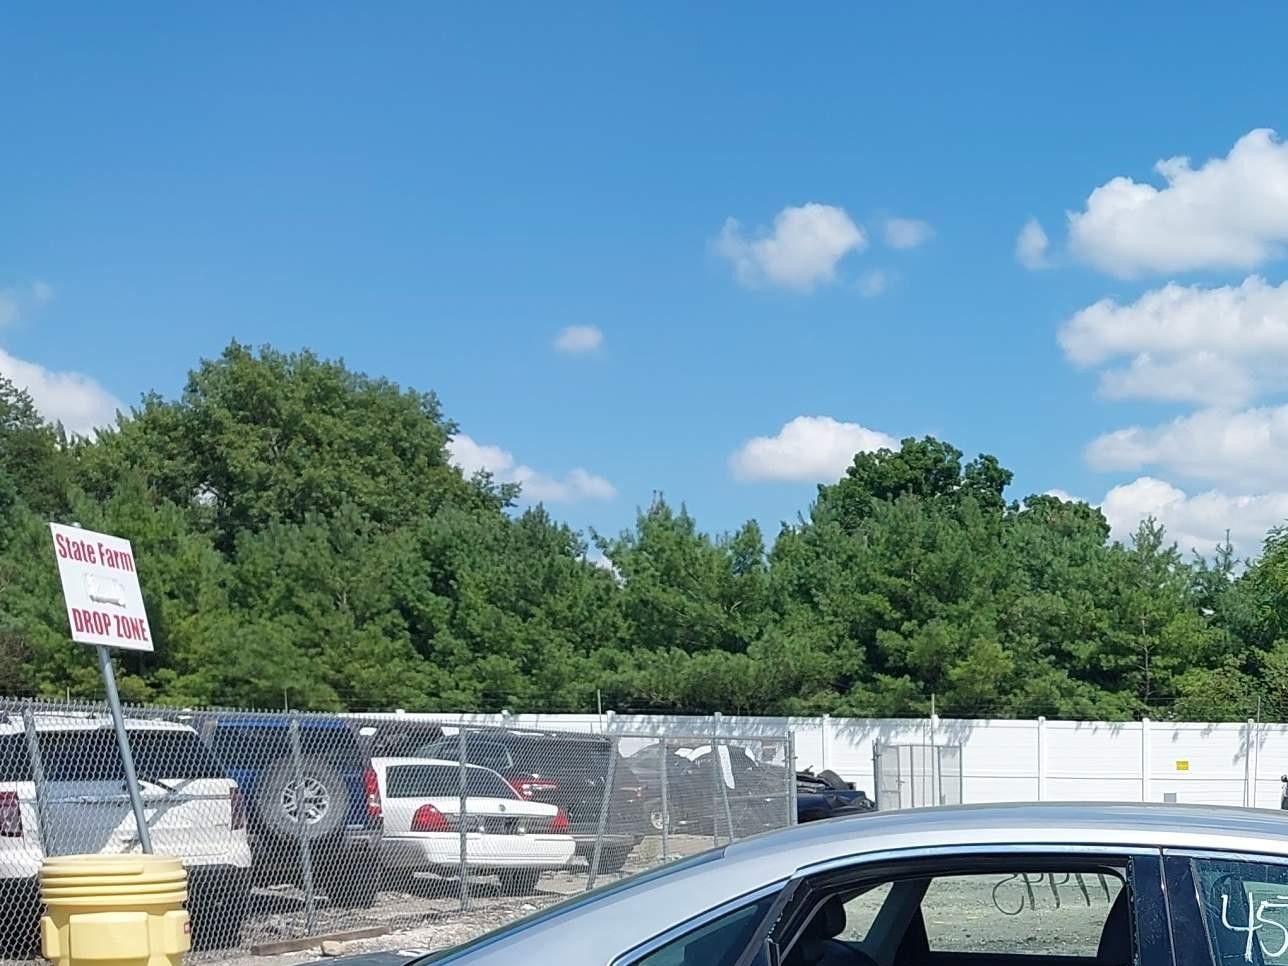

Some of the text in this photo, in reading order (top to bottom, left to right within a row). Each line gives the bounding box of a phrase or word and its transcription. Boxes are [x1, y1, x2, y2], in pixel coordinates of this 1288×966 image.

[55, 533, 134, 573] State Farm
[72, 608, 149, 642] DROP ZONE
